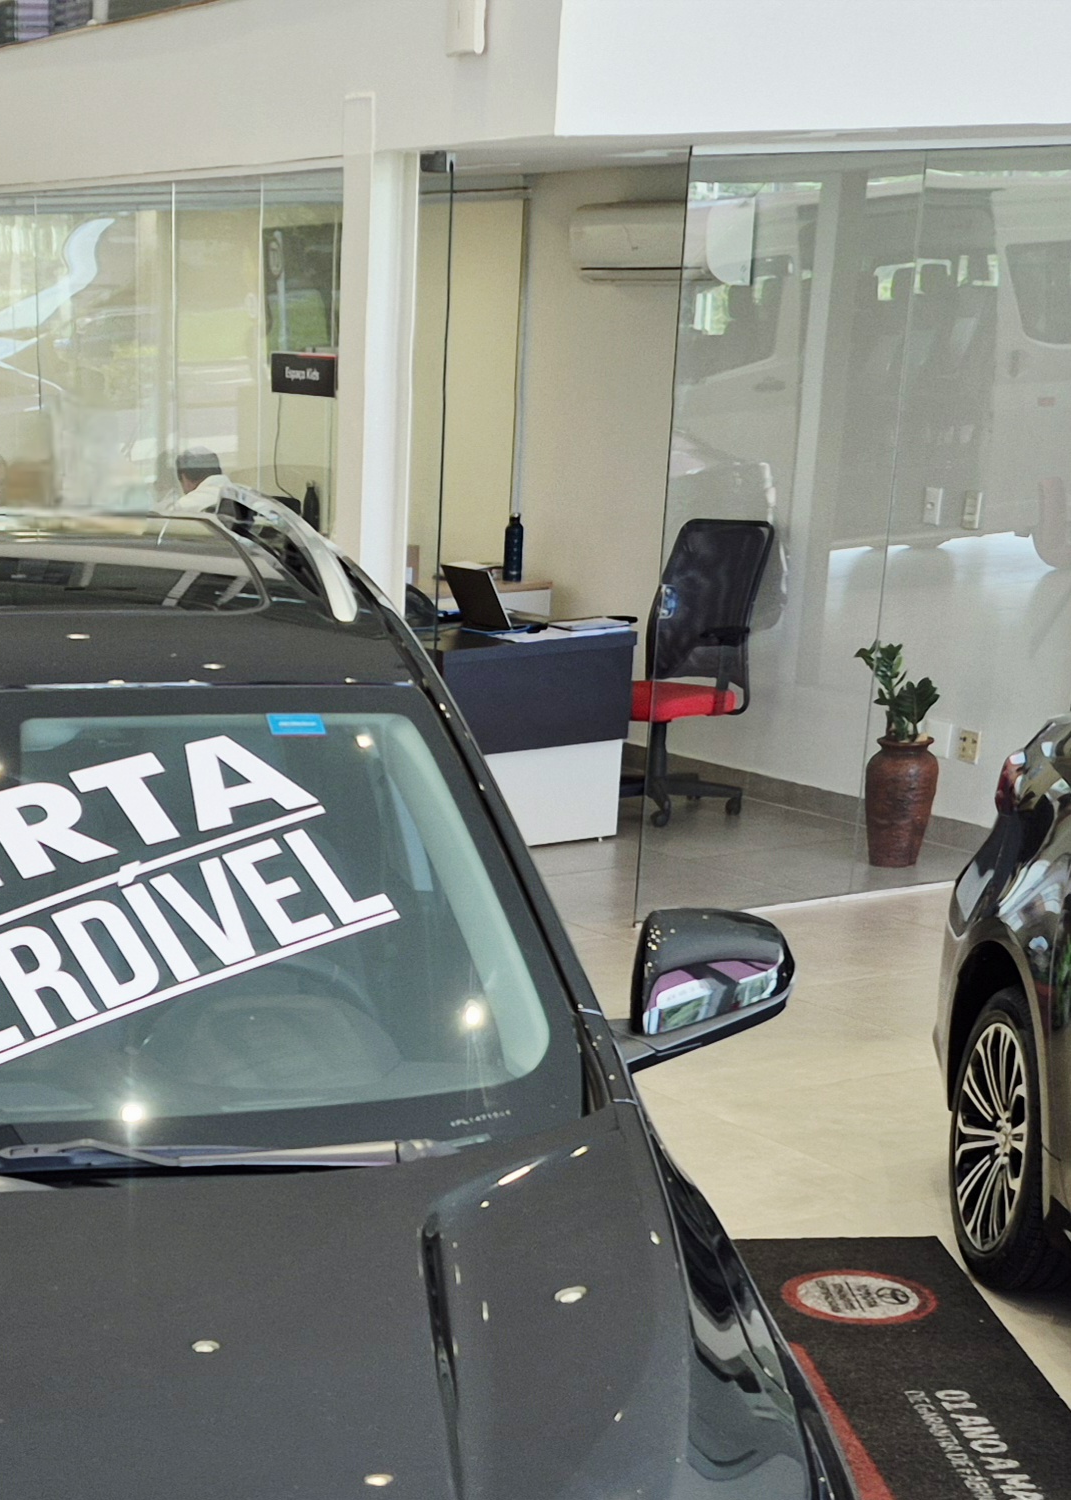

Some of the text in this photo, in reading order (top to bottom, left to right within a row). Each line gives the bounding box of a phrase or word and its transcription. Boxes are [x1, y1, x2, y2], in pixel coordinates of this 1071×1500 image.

[934, 1389, 978, 1412] 01
[904, 1390, 931, 1404] DE
[945, 1453, 975, 1468] DE
[949, 1413, 1009, 1454] ANO
[979, 1455, 1021, 1471] A
